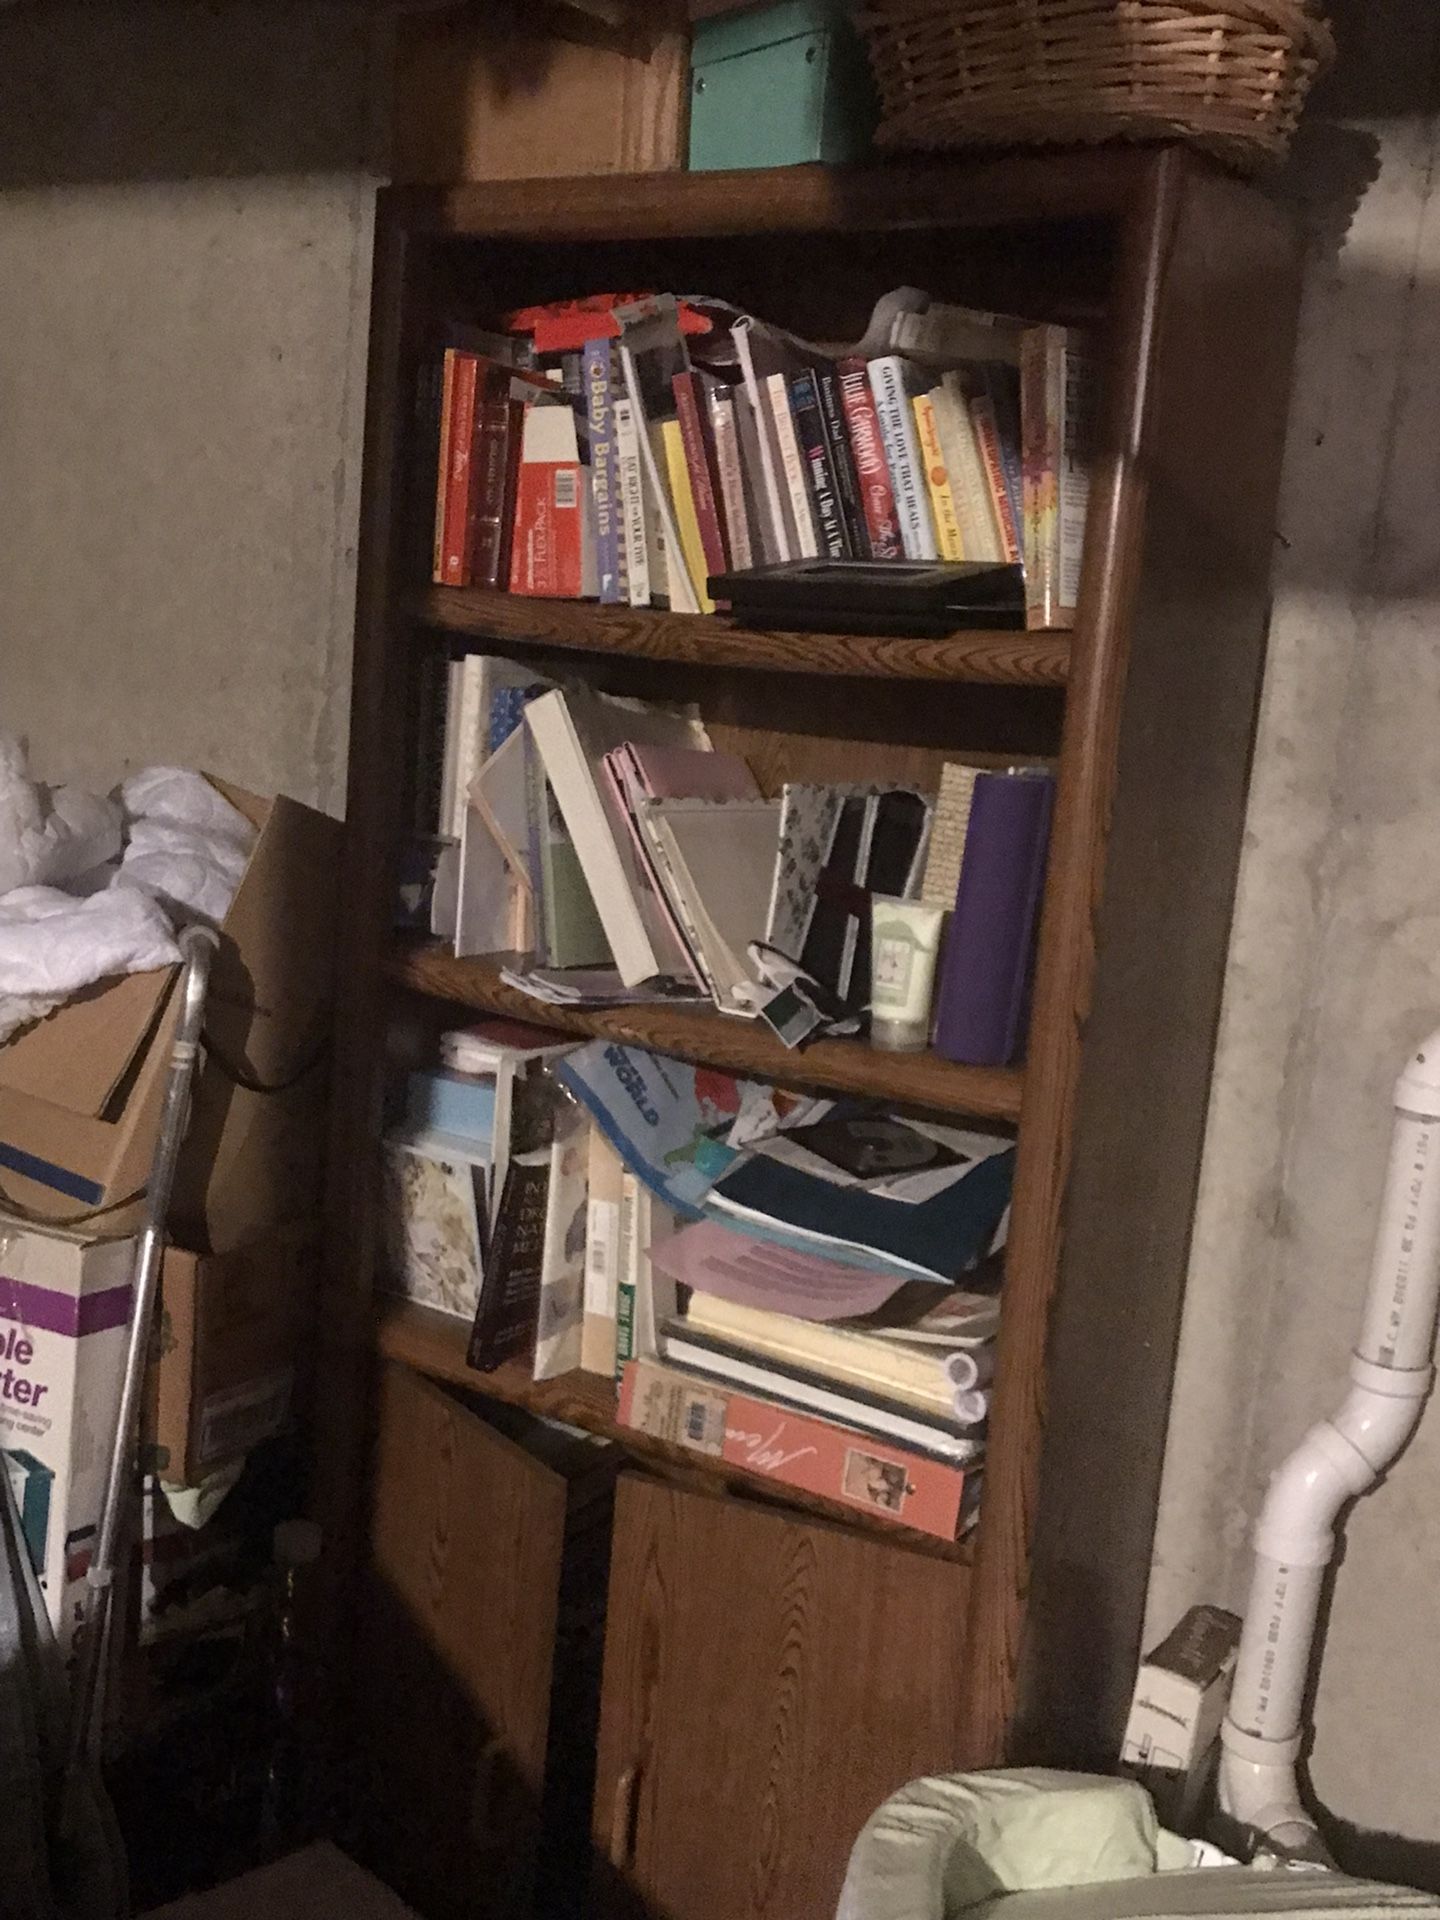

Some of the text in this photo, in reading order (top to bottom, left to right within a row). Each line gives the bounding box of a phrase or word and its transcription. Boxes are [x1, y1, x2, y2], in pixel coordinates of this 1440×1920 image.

[839, 370, 868, 407] JULIE
[882, 366, 897, 405] GIVING
[590, 379, 607, 434] Baby
[822, 376, 842, 441] Business Dad
[889, 407, 902, 430] THE
[848, 404, 881, 476] GARWOOD
[893, 431, 908, 460] LOVE
[627, 455, 636, 474] EAT
[808, 445, 830, 490] Winning
[819, 498, 834, 518] Day
[899, 464, 914, 492] THAT
[594, 442, 611, 536] Bargains
[628, 476, 639, 505] RIGHT
[631, 517, 642, 543] YOUR
[905, 494, 920, 530] HEALS
[633, 546, 643, 567] TYPE
[0, 1368, 49, 1408] ter
